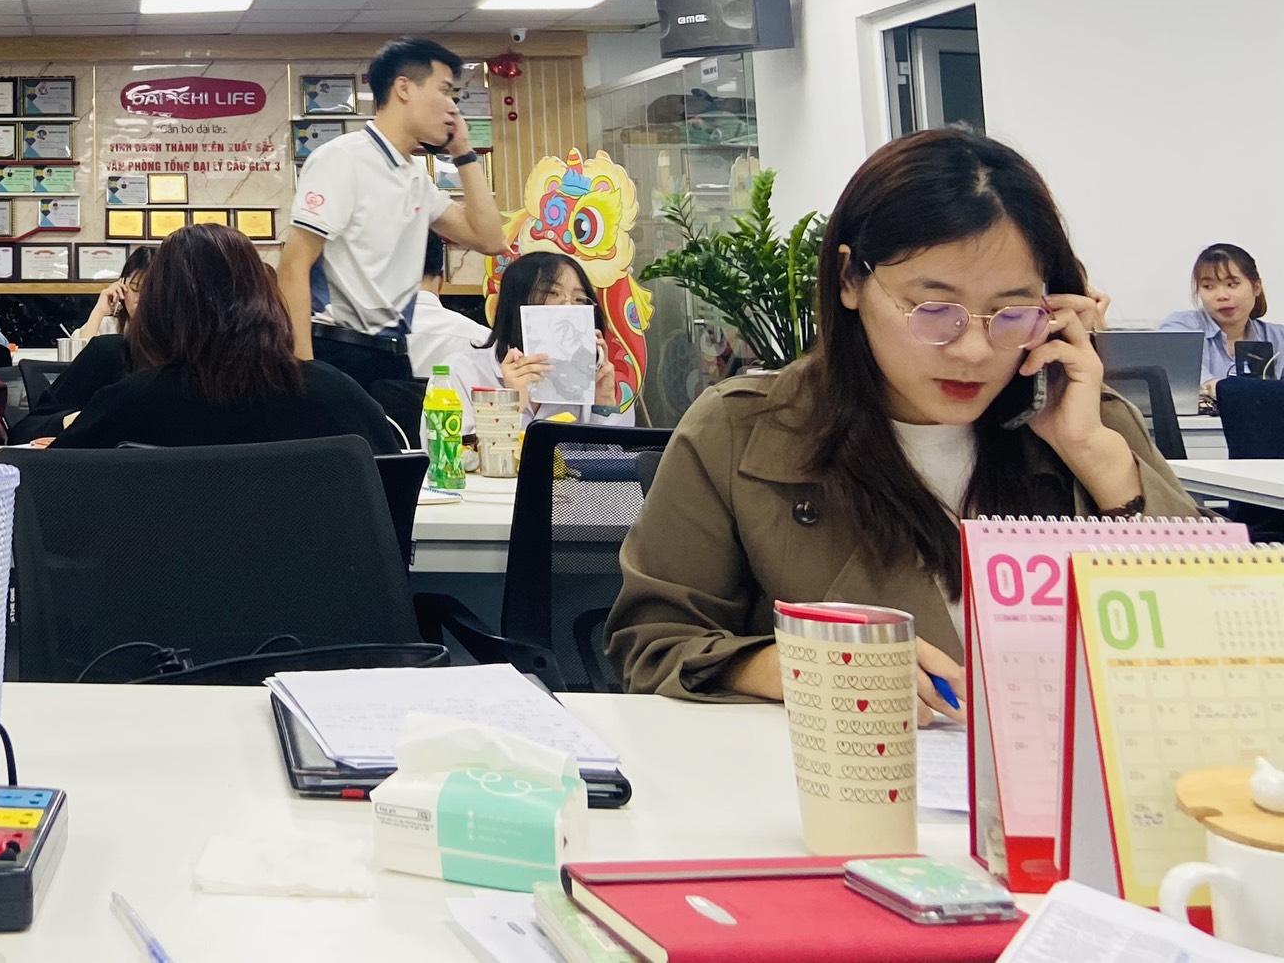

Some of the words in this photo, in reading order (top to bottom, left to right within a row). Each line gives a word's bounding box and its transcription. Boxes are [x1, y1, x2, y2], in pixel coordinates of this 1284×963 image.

[215, 91, 256, 105] LIFE
[181, 123, 194, 134] bó
[196, 123, 210, 134] dài
[165, 140, 198, 152] THÀNH
[128, 158, 161, 171] PHÒNG
[164, 156, 190, 171] TỔNG
[274, 161, 281, 171] 3
[987, 553, 1064, 607] 02
[1097, 589, 1165, 651] 01
